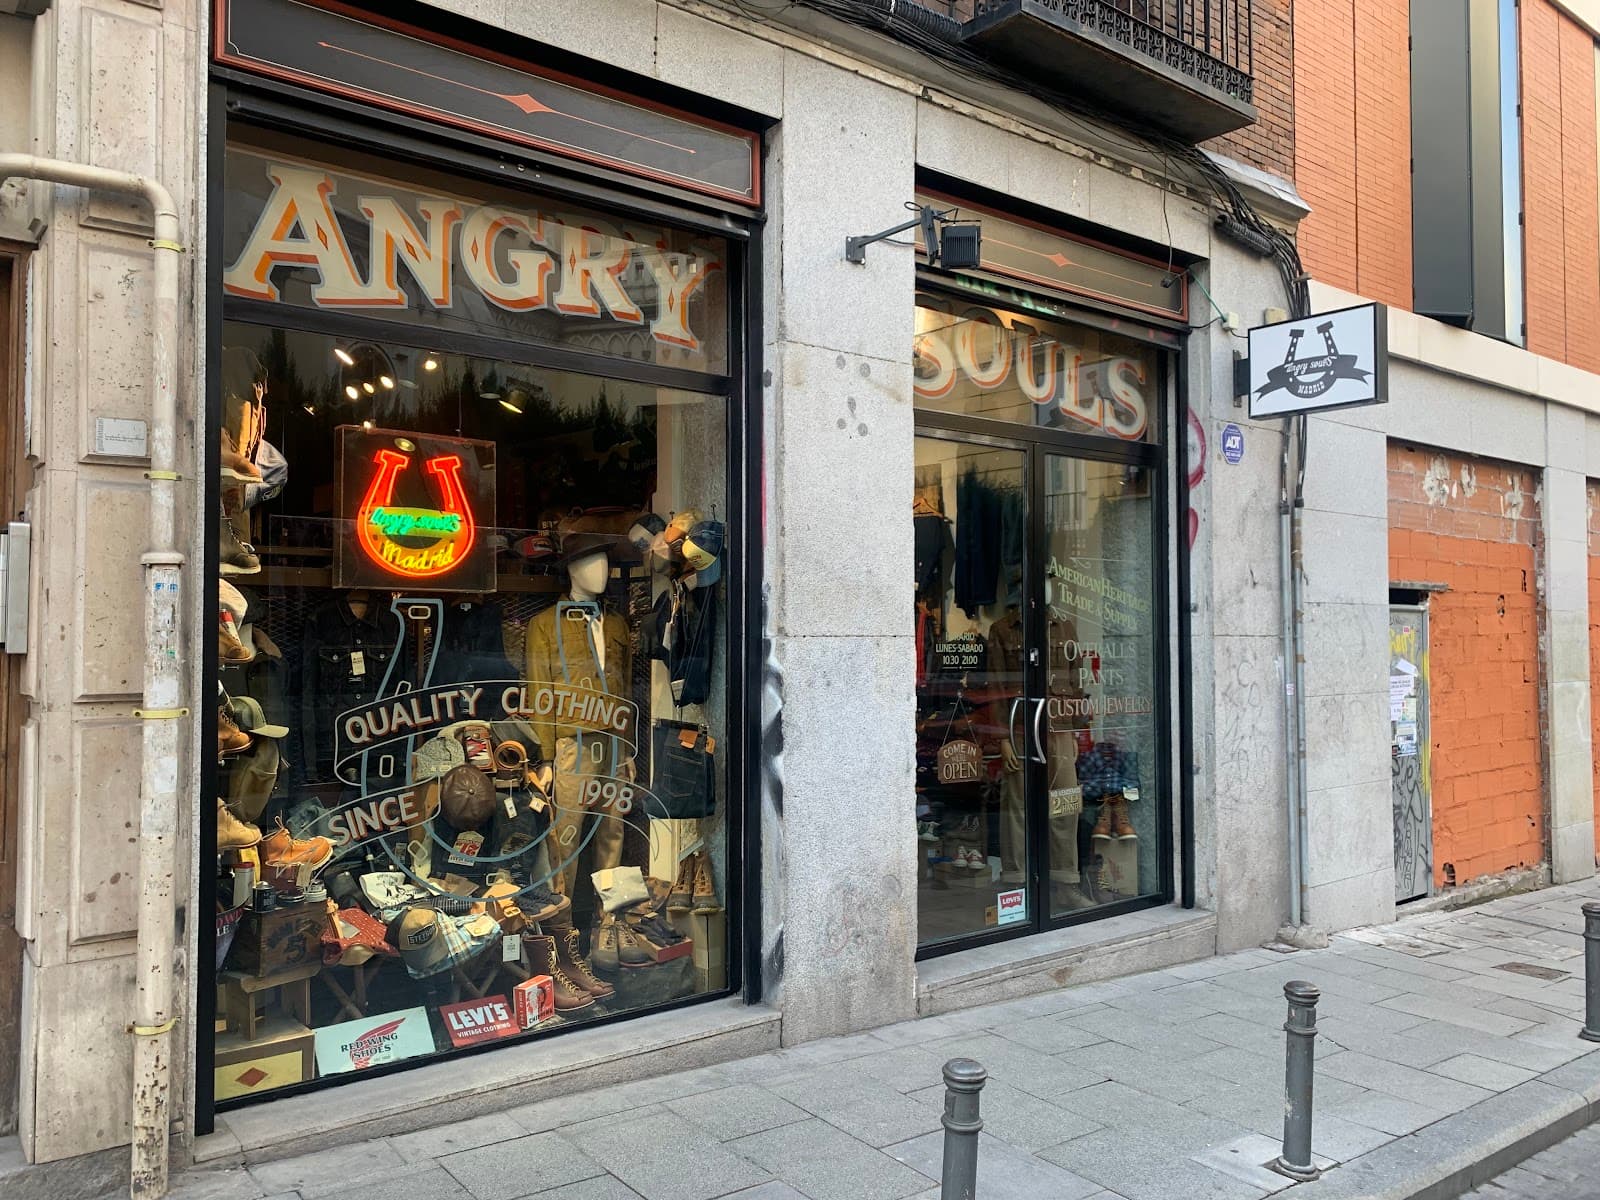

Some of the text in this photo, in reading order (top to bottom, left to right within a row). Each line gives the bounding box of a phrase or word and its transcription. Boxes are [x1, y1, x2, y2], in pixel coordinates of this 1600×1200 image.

[223, 165, 723, 353] ANGRY
[913, 307, 1148, 441] SOULS
[1297, 381, 1325, 394] MADRID
[1225, 435, 1241, 449] ADT
[383, 540, 455, 570] Madrid
[1048, 556, 1100, 596] AMERICAN
[1057, 582, 1095, 614] TRADE
[1103, 602, 1138, 631] SUPPLY
[1063, 639, 1136, 661] OVERALLS
[1078, 667, 1124, 689] PANTS
[344, 686, 631, 745] QUALITY CLOTHING
[1047, 695, 1152, 719] CUSTOM JEWELRY
[943, 743, 977, 759] COME IN
[943, 761, 978, 780] OPEN
[327, 780, 635, 846] SINCE 1998
[447, 1002, 509, 1031] LEVI'S
[457, 1022, 511, 1038] VINTAGE CLOTHING
[341, 1032, 398, 1053] RED WING
[353, 1045, 392, 1059] SHOES
